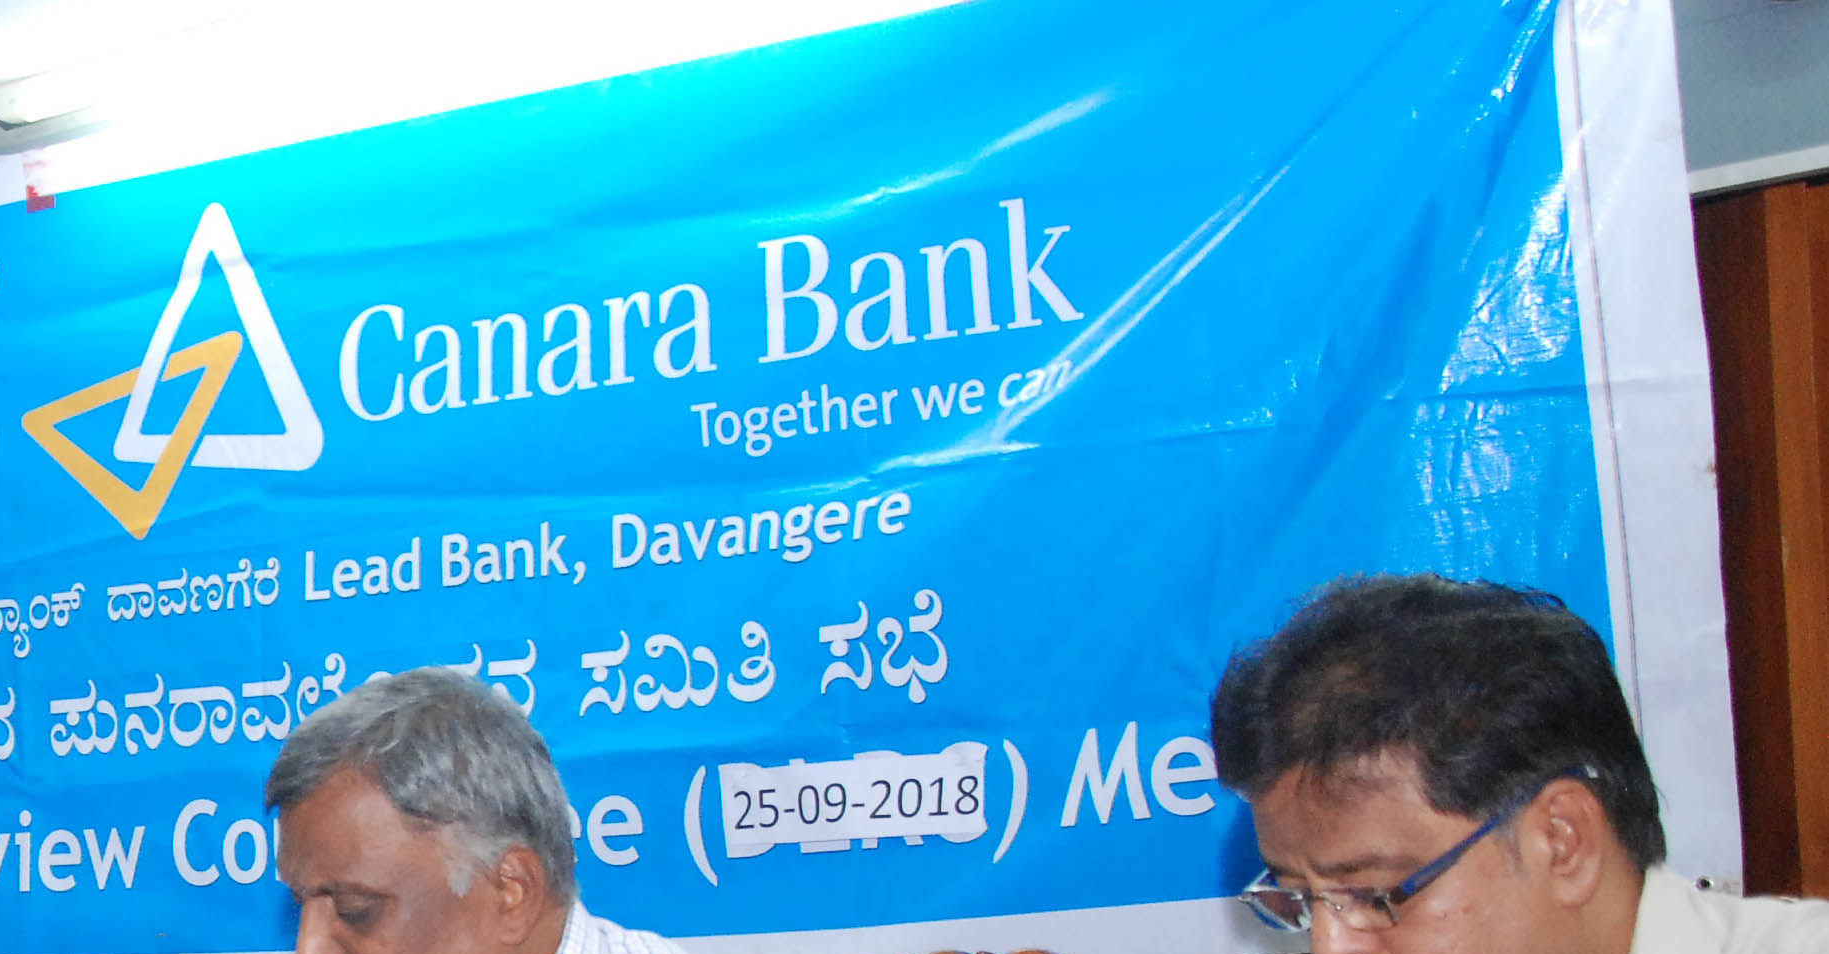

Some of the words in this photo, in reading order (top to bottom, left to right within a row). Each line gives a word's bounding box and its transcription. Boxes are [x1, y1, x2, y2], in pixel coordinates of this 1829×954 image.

[339, 281, 717, 421] Canara
[757, 197, 1084, 364] Bank
[690, 383, 898, 457] Together
[912, 379, 985, 420] we
[997, 359, 1074, 407] can
[107, 557, 281, 621] ದಾವಣಗೆರೆ
[305, 536, 421, 601] Lead
[441, 521, 587, 587] Bank,
[612, 492, 912, 569] Davangere
[579, 621, 777, 717] ಸಮಿತಿ
[819, 588, 949, 704] ಸಭೆ
[732, 775, 980, 830] 25-09-2018
